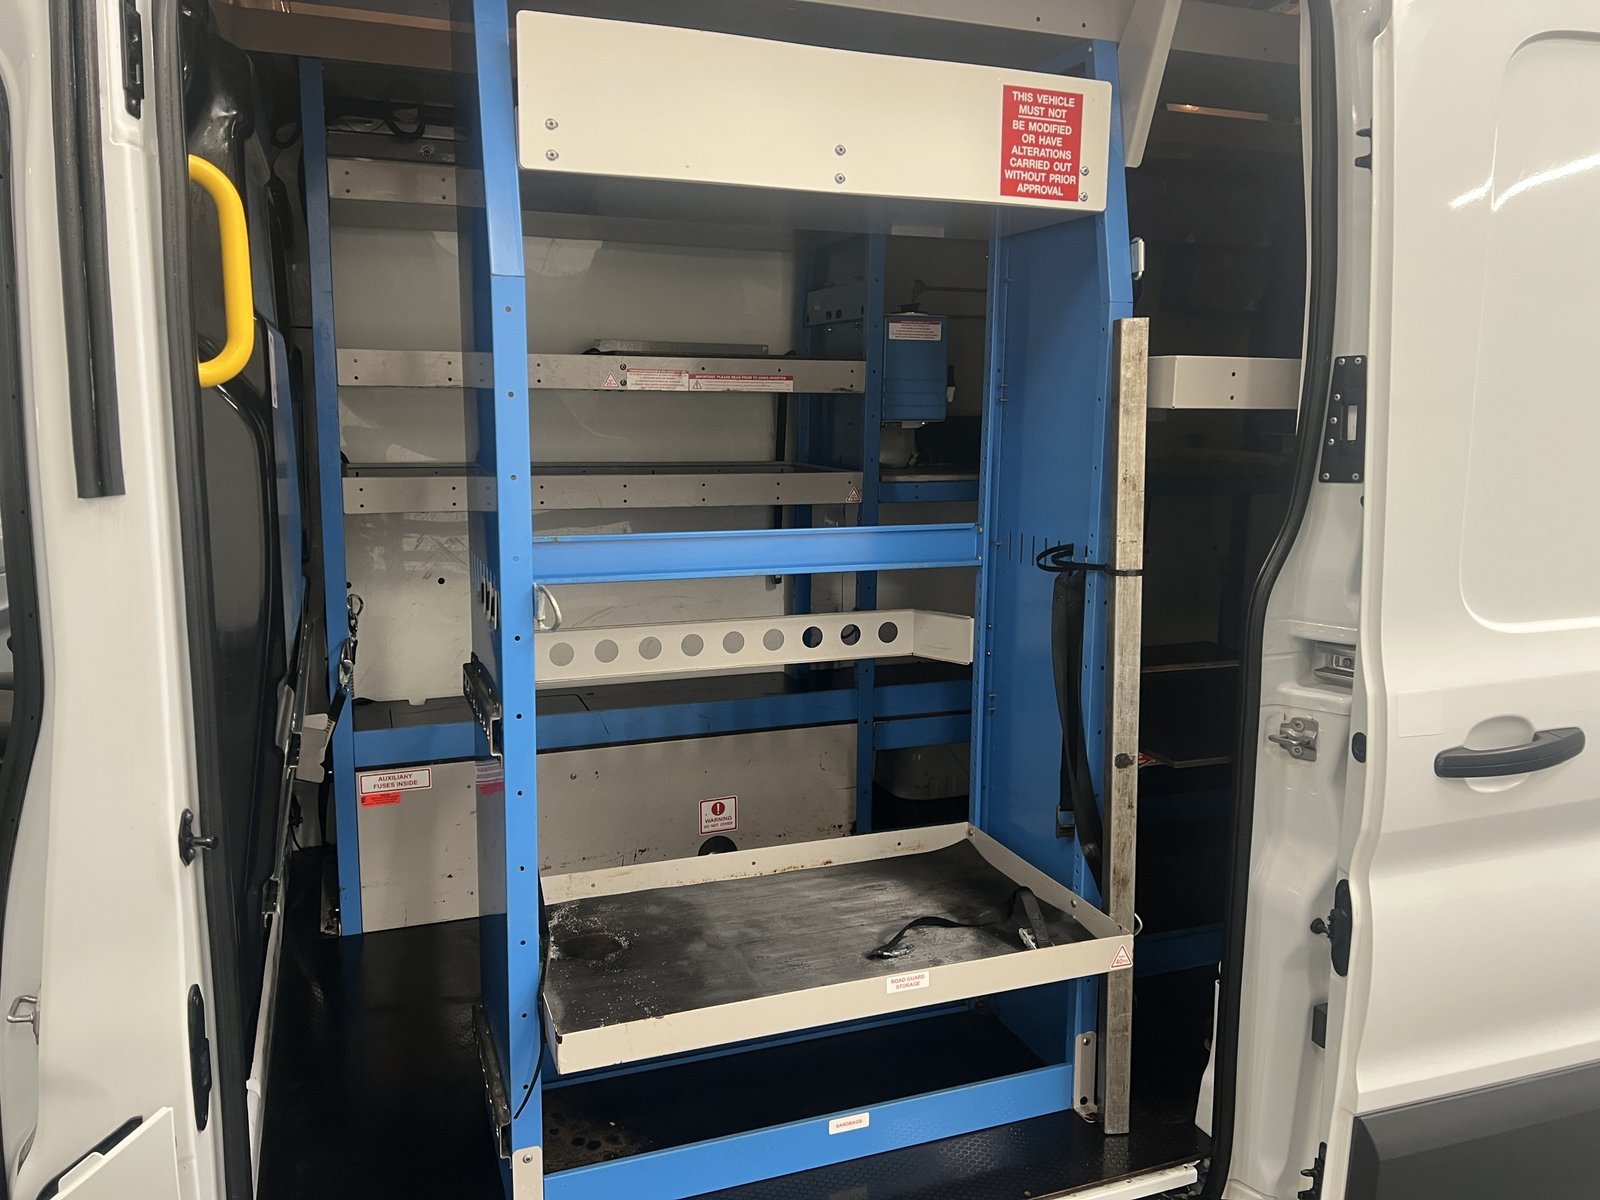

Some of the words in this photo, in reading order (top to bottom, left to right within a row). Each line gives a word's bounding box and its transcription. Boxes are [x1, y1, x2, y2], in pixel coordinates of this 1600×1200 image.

[1012, 91, 1034, 102] THIS
[1037, 94, 1075, 107] VEHICLE
[1019, 105, 1045, 117] MUST
[1048, 108, 1067, 119] NOT
[1012, 120, 1025, 130] BE
[1028, 121, 1072, 135] MODIFIED
[1022, 134, 1035, 144] OR
[1039, 136, 1063, 146] HAVE
[1011, 145, 1072, 159] ALTERATIONS
[1010, 158, 1049, 169] CARRIED
[1053, 162, 1072, 172] OUT
[1004, 170, 1046, 182] WITHOUT
[1049, 174, 1076, 185] PRIOR
[1017, 183, 1063, 196] APPROVAL
[378, 773, 413, 781] AUXILIARY
[896, 981, 920, 989] STORAGE
[836, 1119, 863, 1128] SANDBAGS
